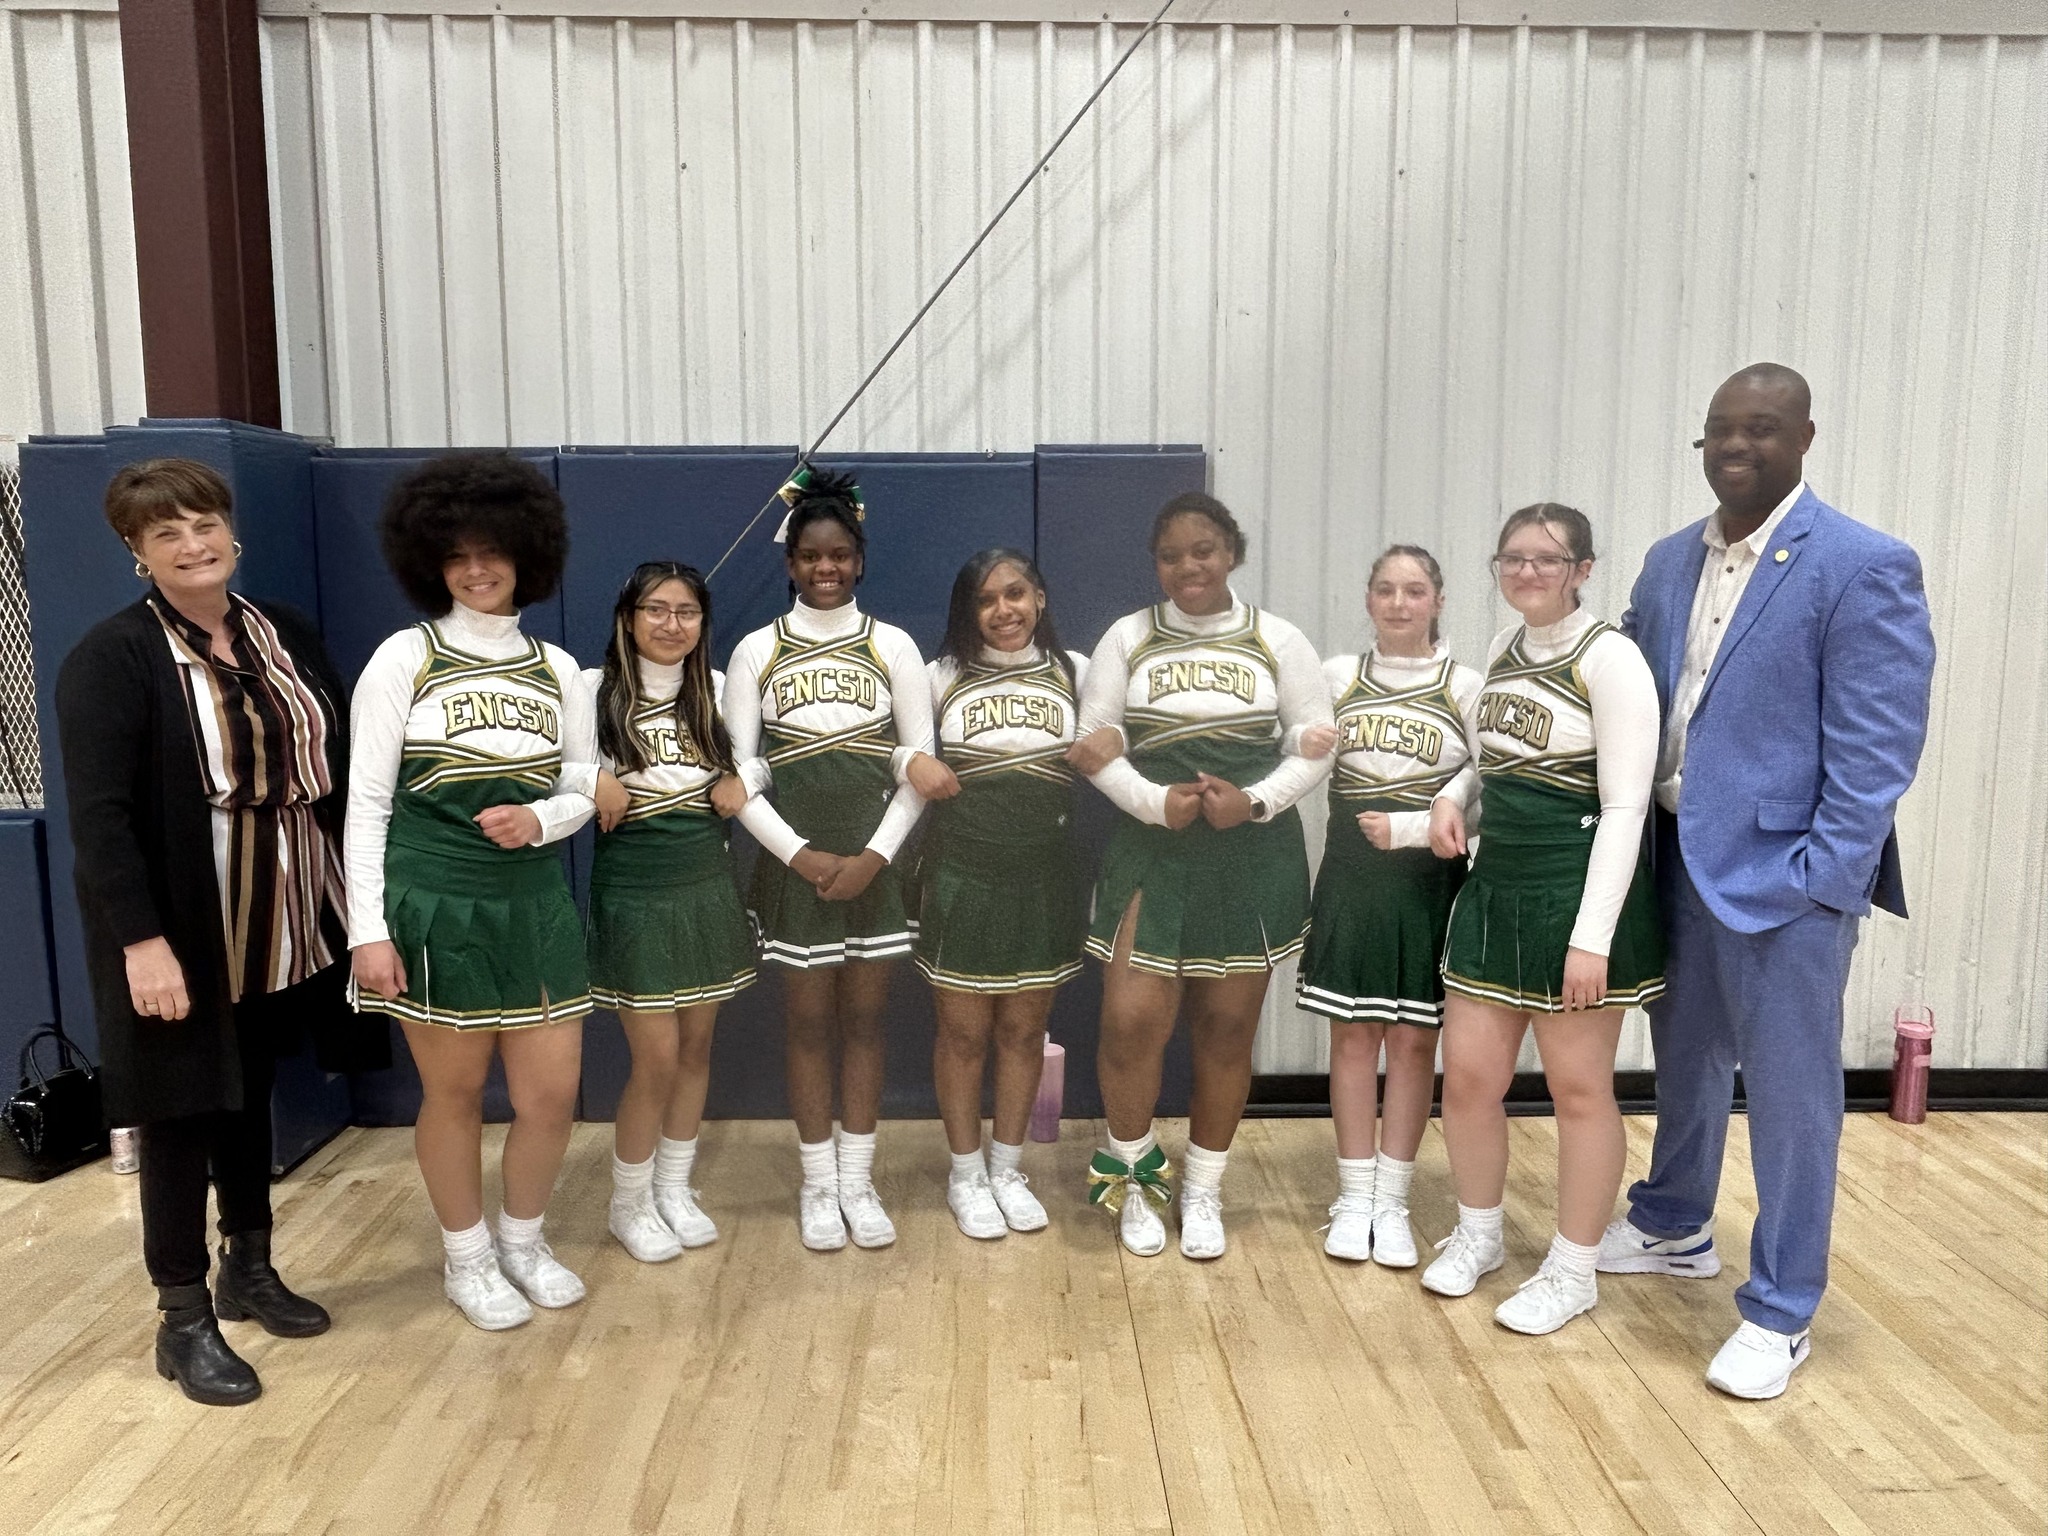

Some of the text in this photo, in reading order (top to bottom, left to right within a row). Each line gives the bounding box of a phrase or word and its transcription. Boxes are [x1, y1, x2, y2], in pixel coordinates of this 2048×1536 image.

[773, 668, 876, 719] ENCSD
[1148, 660, 1256, 705] ENCSD
[441, 691, 558, 745] ENCSD
[962, 694, 1064, 742] ENCSD
[1338, 714, 1444, 766] ENCSD
